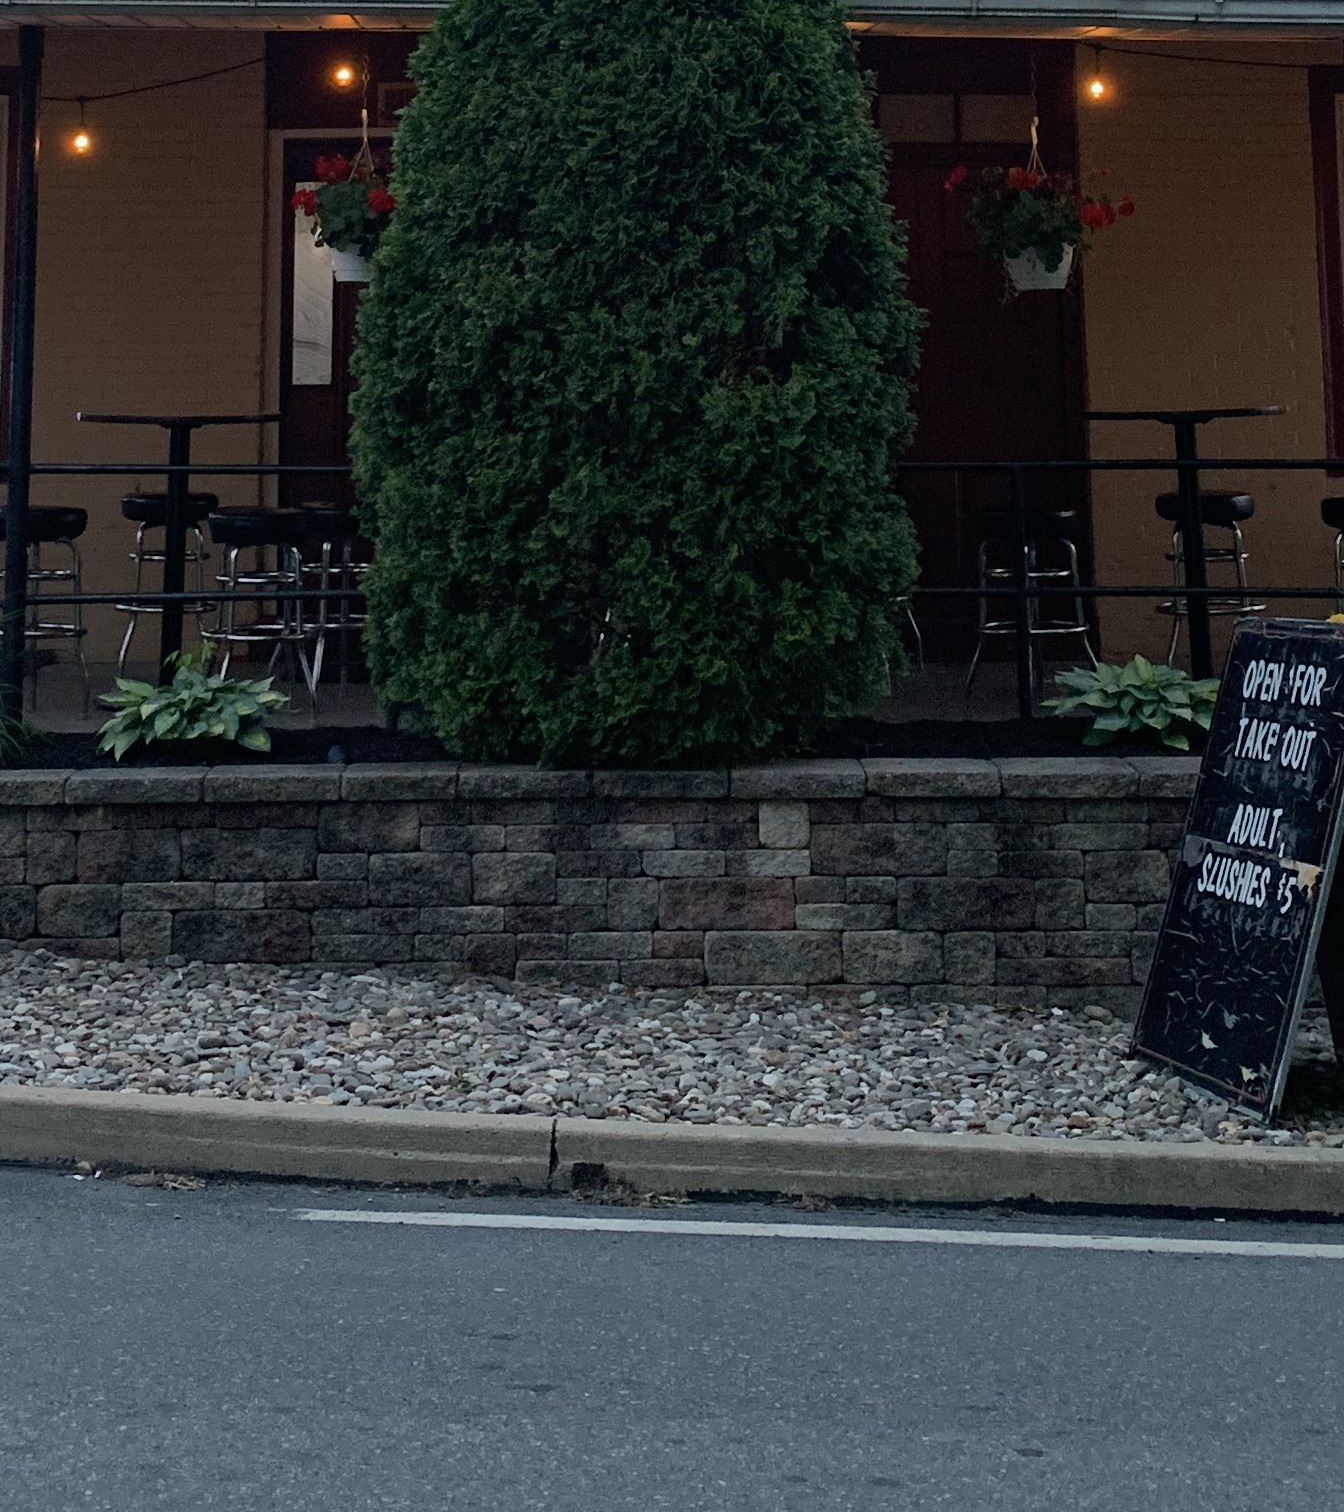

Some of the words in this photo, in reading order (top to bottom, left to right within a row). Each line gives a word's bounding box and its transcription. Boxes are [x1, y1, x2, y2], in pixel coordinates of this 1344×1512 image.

[1242, 659, 1285, 702] OPEN
[1290, 664, 1327, 706] FOR
[1234, 717, 1281, 761] TAKE
[1281, 725, 1317, 772] OUT
[1226, 803, 1283, 849] ADULT
[1197, 852, 1271, 908] SLUSHIES
[1277, 872, 1297, 914] $5
